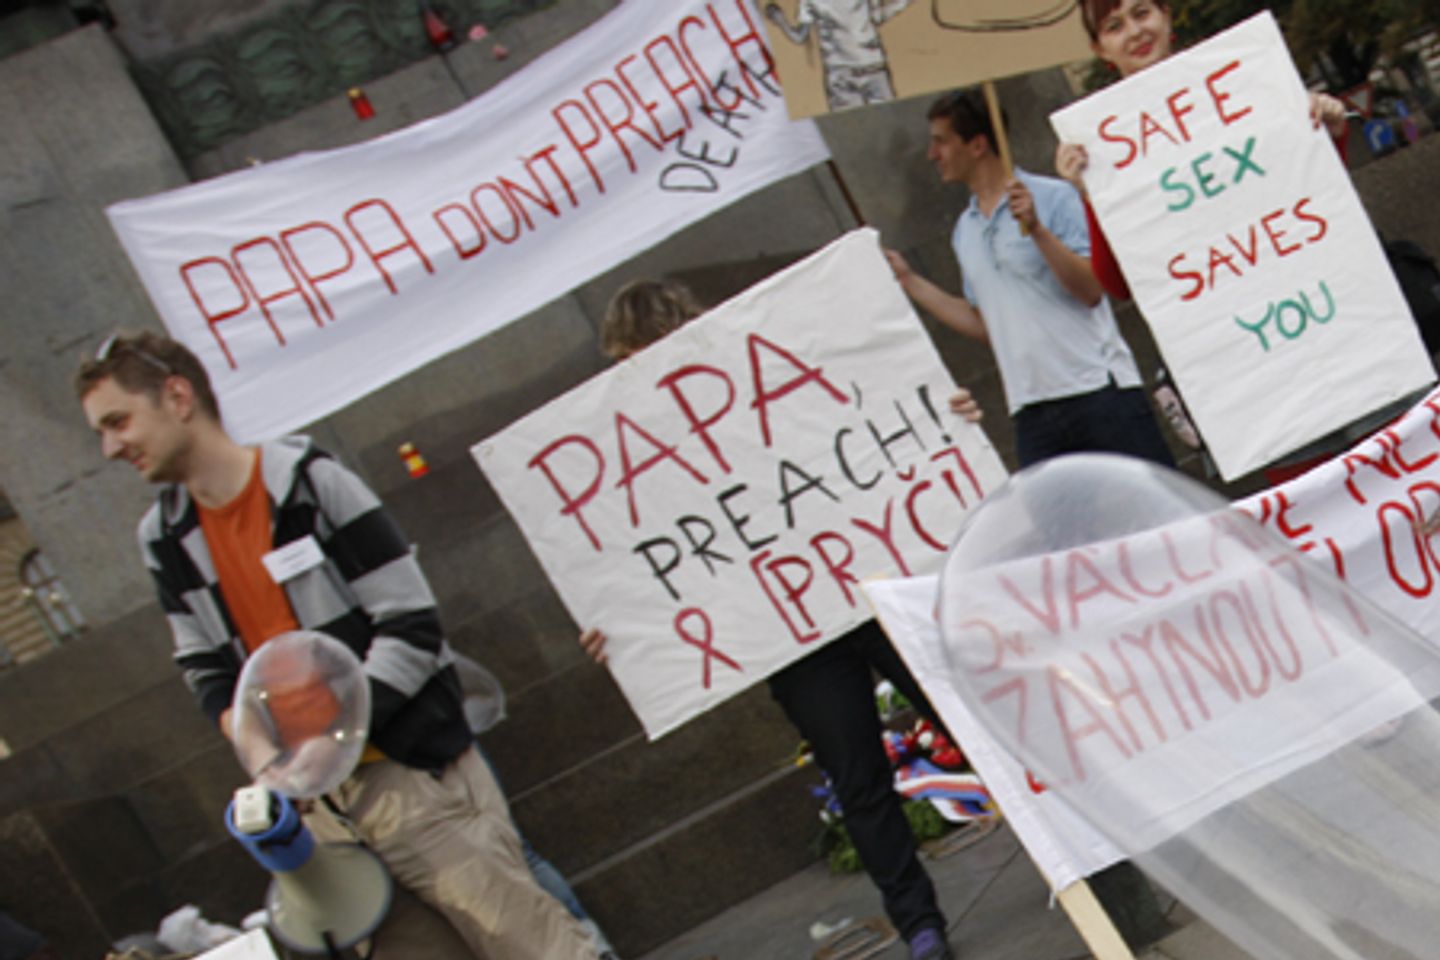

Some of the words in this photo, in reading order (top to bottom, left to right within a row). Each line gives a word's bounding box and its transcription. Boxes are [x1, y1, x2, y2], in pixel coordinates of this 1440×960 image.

[1098, 60, 1253, 170] SAFE
[178, 198, 435, 370] PAPA
[432, 145, 577, 261] DONT
[552, 0, 782, 194] PREACH
[1160, 137, 1267, 212] SEX
[1167, 198, 1329, 302] SAVES
[1235, 281, 1336, 352] YOU
[633, 384, 953, 602] PREACH!
